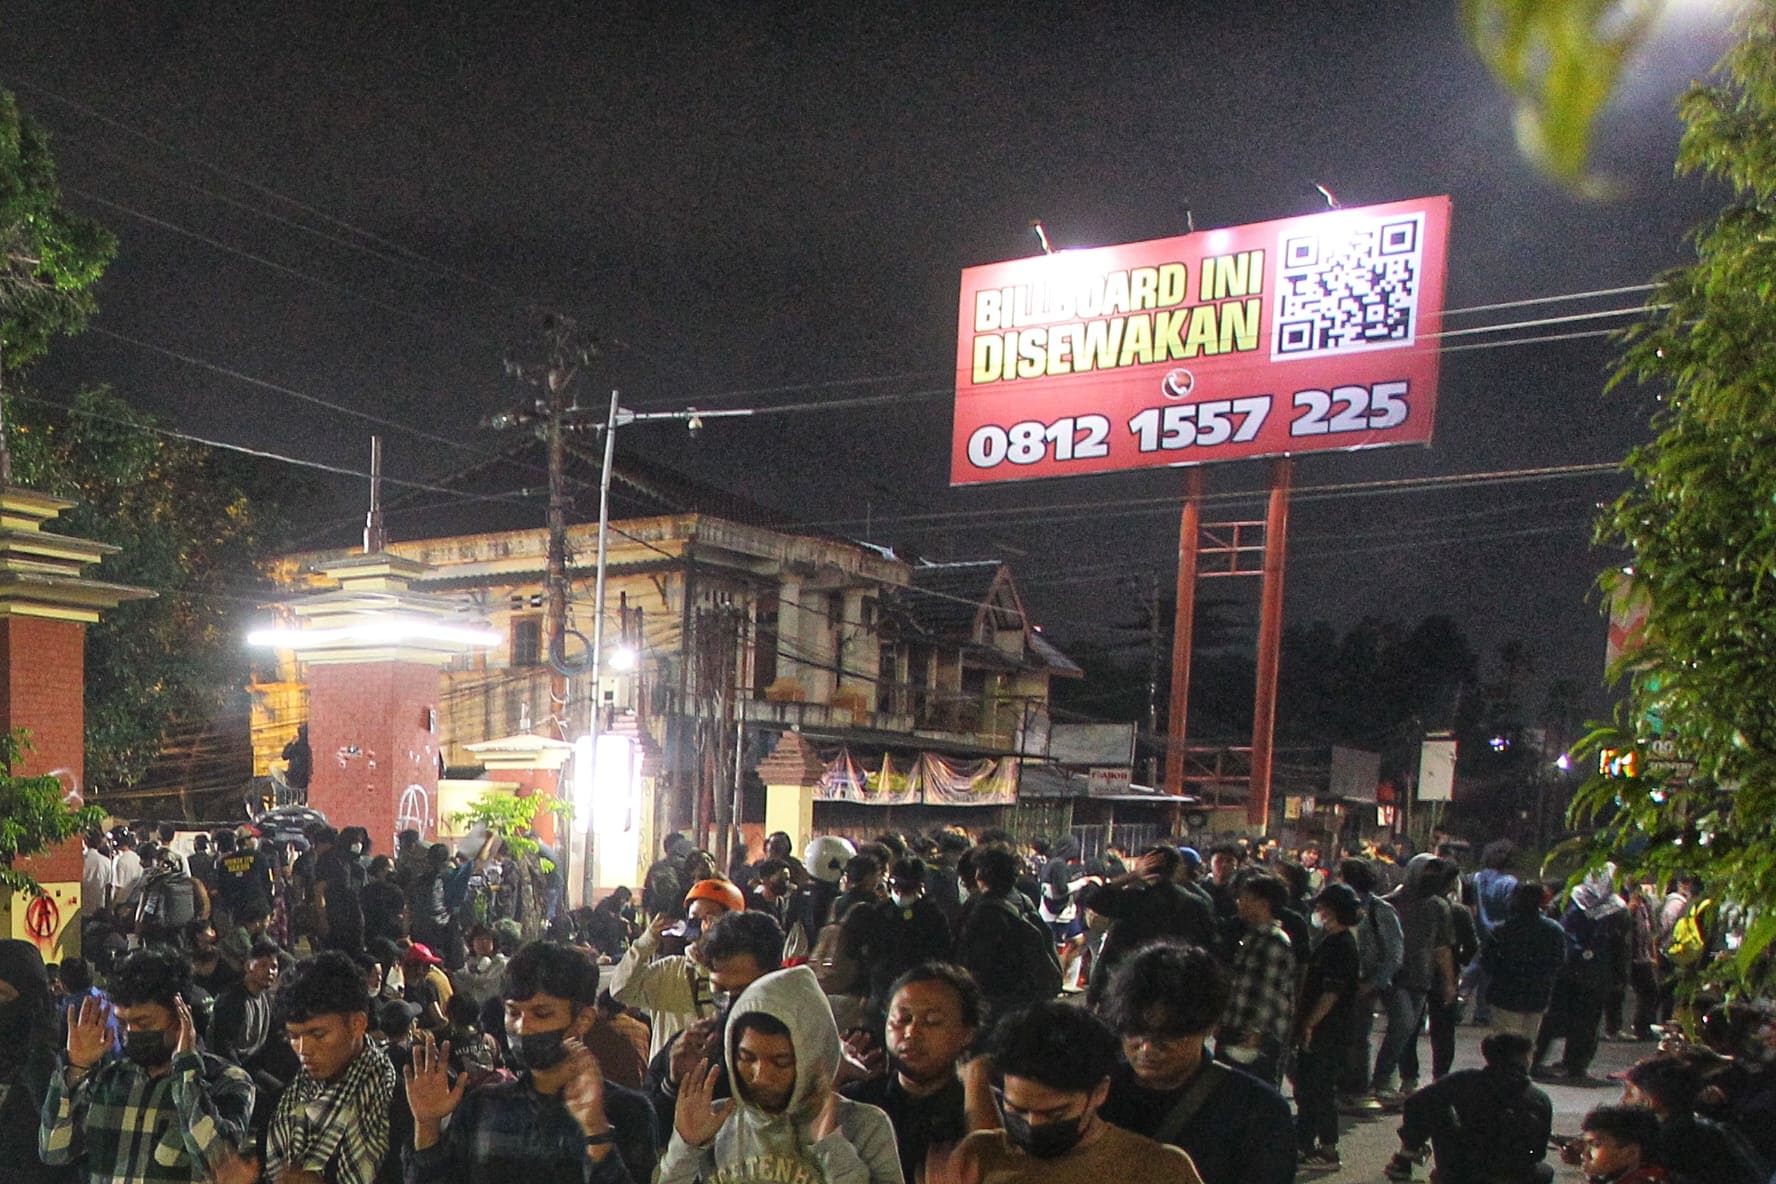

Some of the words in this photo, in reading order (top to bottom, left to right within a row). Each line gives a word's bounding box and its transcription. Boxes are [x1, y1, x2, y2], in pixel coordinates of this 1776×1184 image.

[1200, 249, 1265, 302] INI
[972, 298, 1262, 385] DISEWAKAN
[967, 414, 1110, 468] 0812
[1130, 396, 1271, 453] 1557
[1291, 381, 1409, 437] 225
